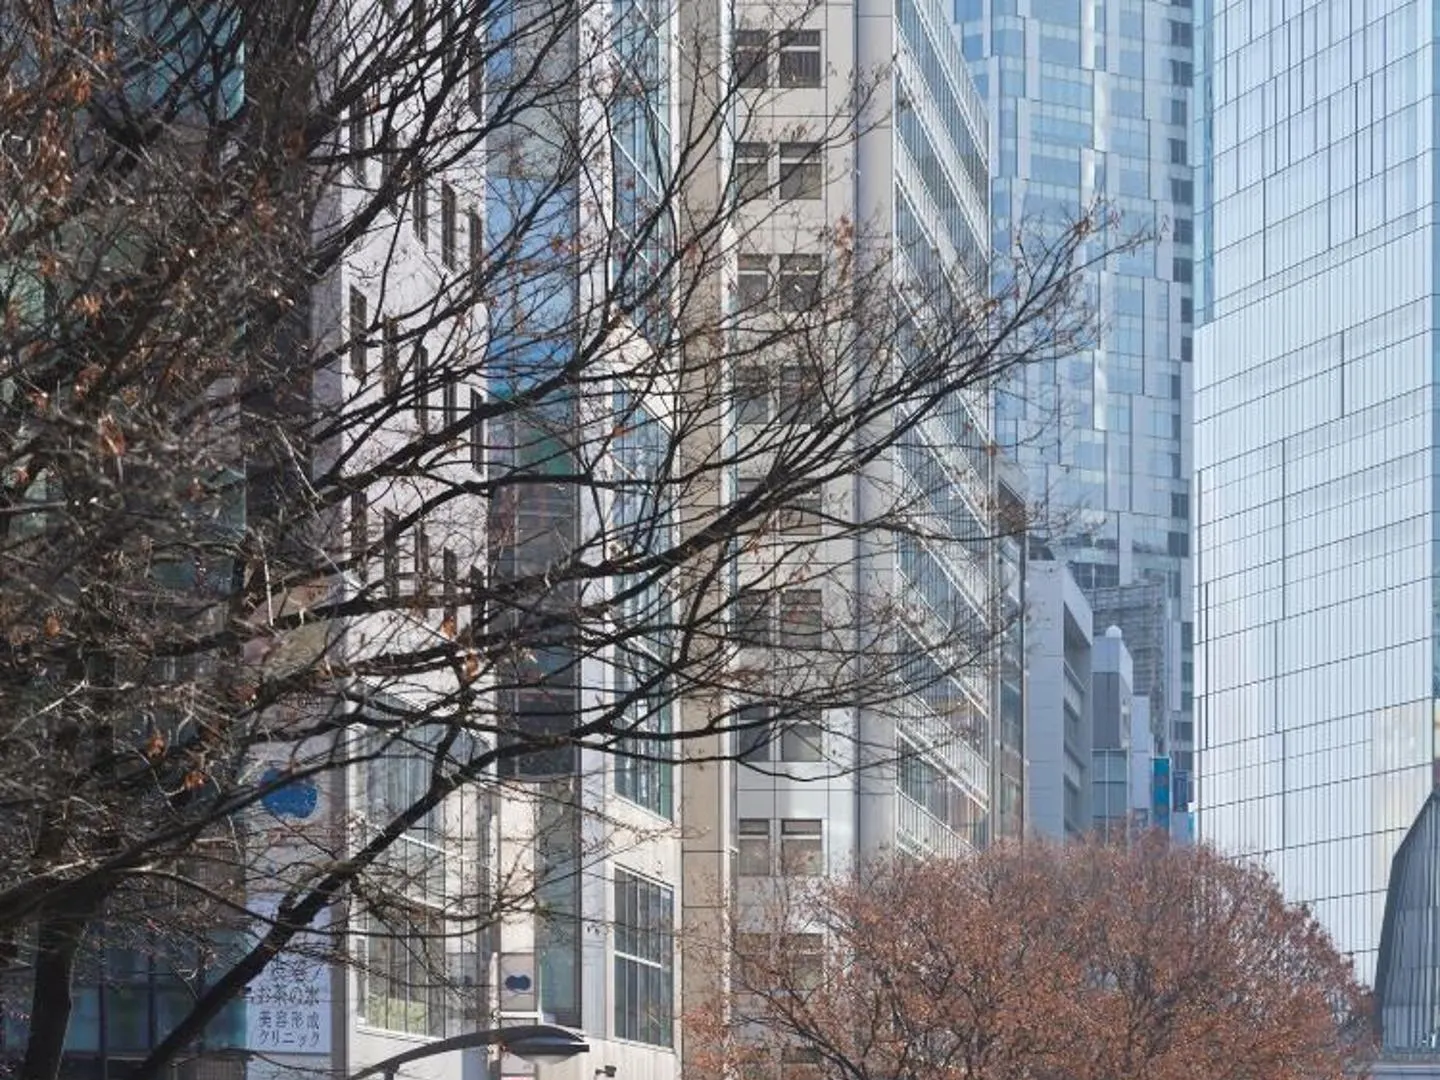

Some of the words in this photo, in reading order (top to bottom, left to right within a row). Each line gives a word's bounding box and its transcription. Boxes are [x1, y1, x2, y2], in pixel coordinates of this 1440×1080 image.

[259, 1030, 320, 1048] クリニック
